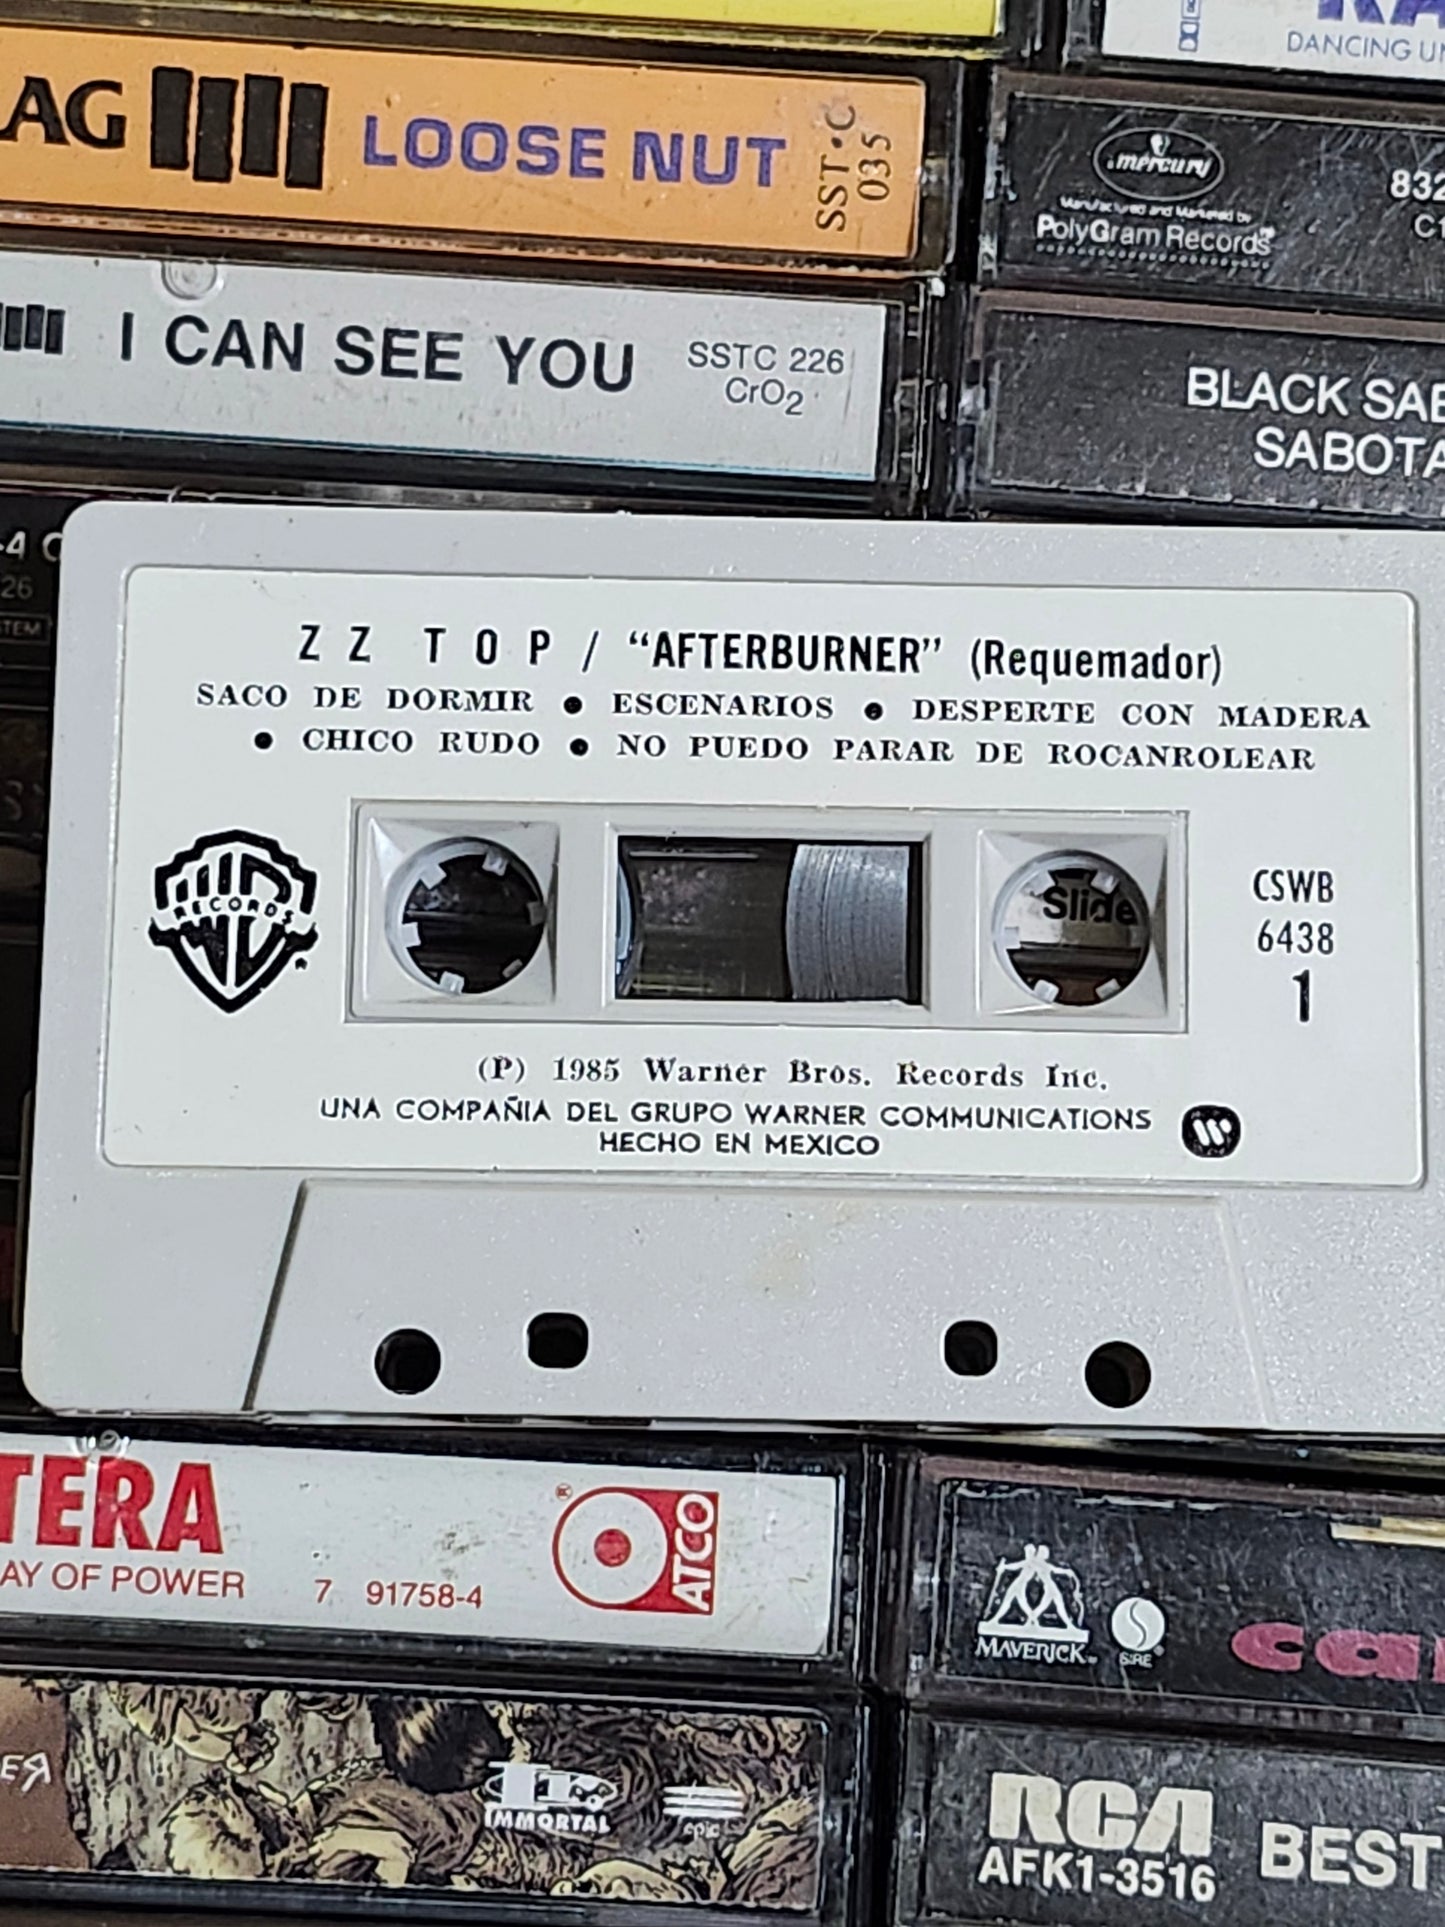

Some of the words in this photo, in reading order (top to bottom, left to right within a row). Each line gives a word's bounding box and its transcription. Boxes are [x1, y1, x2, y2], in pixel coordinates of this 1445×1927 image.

[1287, 31, 1412, 62] DANCING
[1419, 41, 1445, 63] U
[363, 116, 607, 179] LOOSE
[632, 132, 786, 187] NUT
[857, 134, 892, 201] 035
[1115, 154, 1213, 179] mercury
[1390, 169, 1445, 201] 832
[1036, 214, 1161, 246] PolyGram
[1166, 225, 1272, 256] Records
[121, 312, 135, 361] I
[164, 315, 304, 372] CAN
[334, 325, 464, 381] SEE
[495, 336, 635, 392] YOU
[687, 341, 777, 371] SSTC
[788, 348, 845, 374] 226
[1187, 366, 1352, 417] BLACK
[970, 638, 1222, 686] (Requemador)
[197, 684, 288, 709] SACO
[313, 686, 362, 709] DE
[387, 688, 535, 713] DORMIR
[612, 692, 834, 719] ESCENARIOS
[912, 699, 1096, 724] DESPERTE
[1121, 703, 1193, 726] CON
[1217, 705, 1371, 729] MADERA
[302, 728, 414, 754] CHICO
[438, 731, 541, 755] RUDO
[617, 734, 666, 758] NO
[689, 735, 809, 760] PUEDO
[832, 738, 954, 763] PARAR
[976, 742, 1023, 764] DE
[1047, 742, 1316, 771] ROCANROLEAR
[1252, 869, 1335, 904] CSWB
[1256, 920, 1335, 955] 6438
[1292, 968, 1310, 1022] 1
[478, 1056, 526, 1083] (P)
[553, 1057, 620, 1083] 1985
[645, 1058, 768, 1084] Warner
[788, 1060, 872, 1087] Bros.
[896, 1062, 1024, 1088] Records
[1045, 1065, 1108, 1091] Inc.
[320, 1097, 381, 1120] UNA
[397, 1096, 551, 1124] COMPAÑIA
[567, 1101, 618, 1123] DEL
[631, 1102, 732, 1124] GRUPO
[745, 1104, 866, 1126] WARNER
[880, 1105, 1152, 1131] COMMUNICATIONS
[599, 1131, 701, 1154] HECHO
[715, 1133, 751, 1155] EN
[765, 1134, 880, 1156] MEXICO
[0, 1452, 224, 1554] TERA
[671, 1493, 714, 1611] ATCO
[0, 1560, 43, 1589] AY
[52, 1562, 103, 1592] OF
[111, 1565, 245, 1599] POWER
[314, 1579, 333, 1604] 7
[366, 1580, 483, 1609] 91758-4
[975, 1636, 1088, 1664] MAVERICK
[1231, 1622, 1445, 1684] ca
[484, 1807, 611, 1834] IMMORTAL
[989, 1772, 1214, 1857] RCA
[978, 1847, 1216, 1902] AFK1-3516
[1260, 1821, 1443, 1890] BEST
